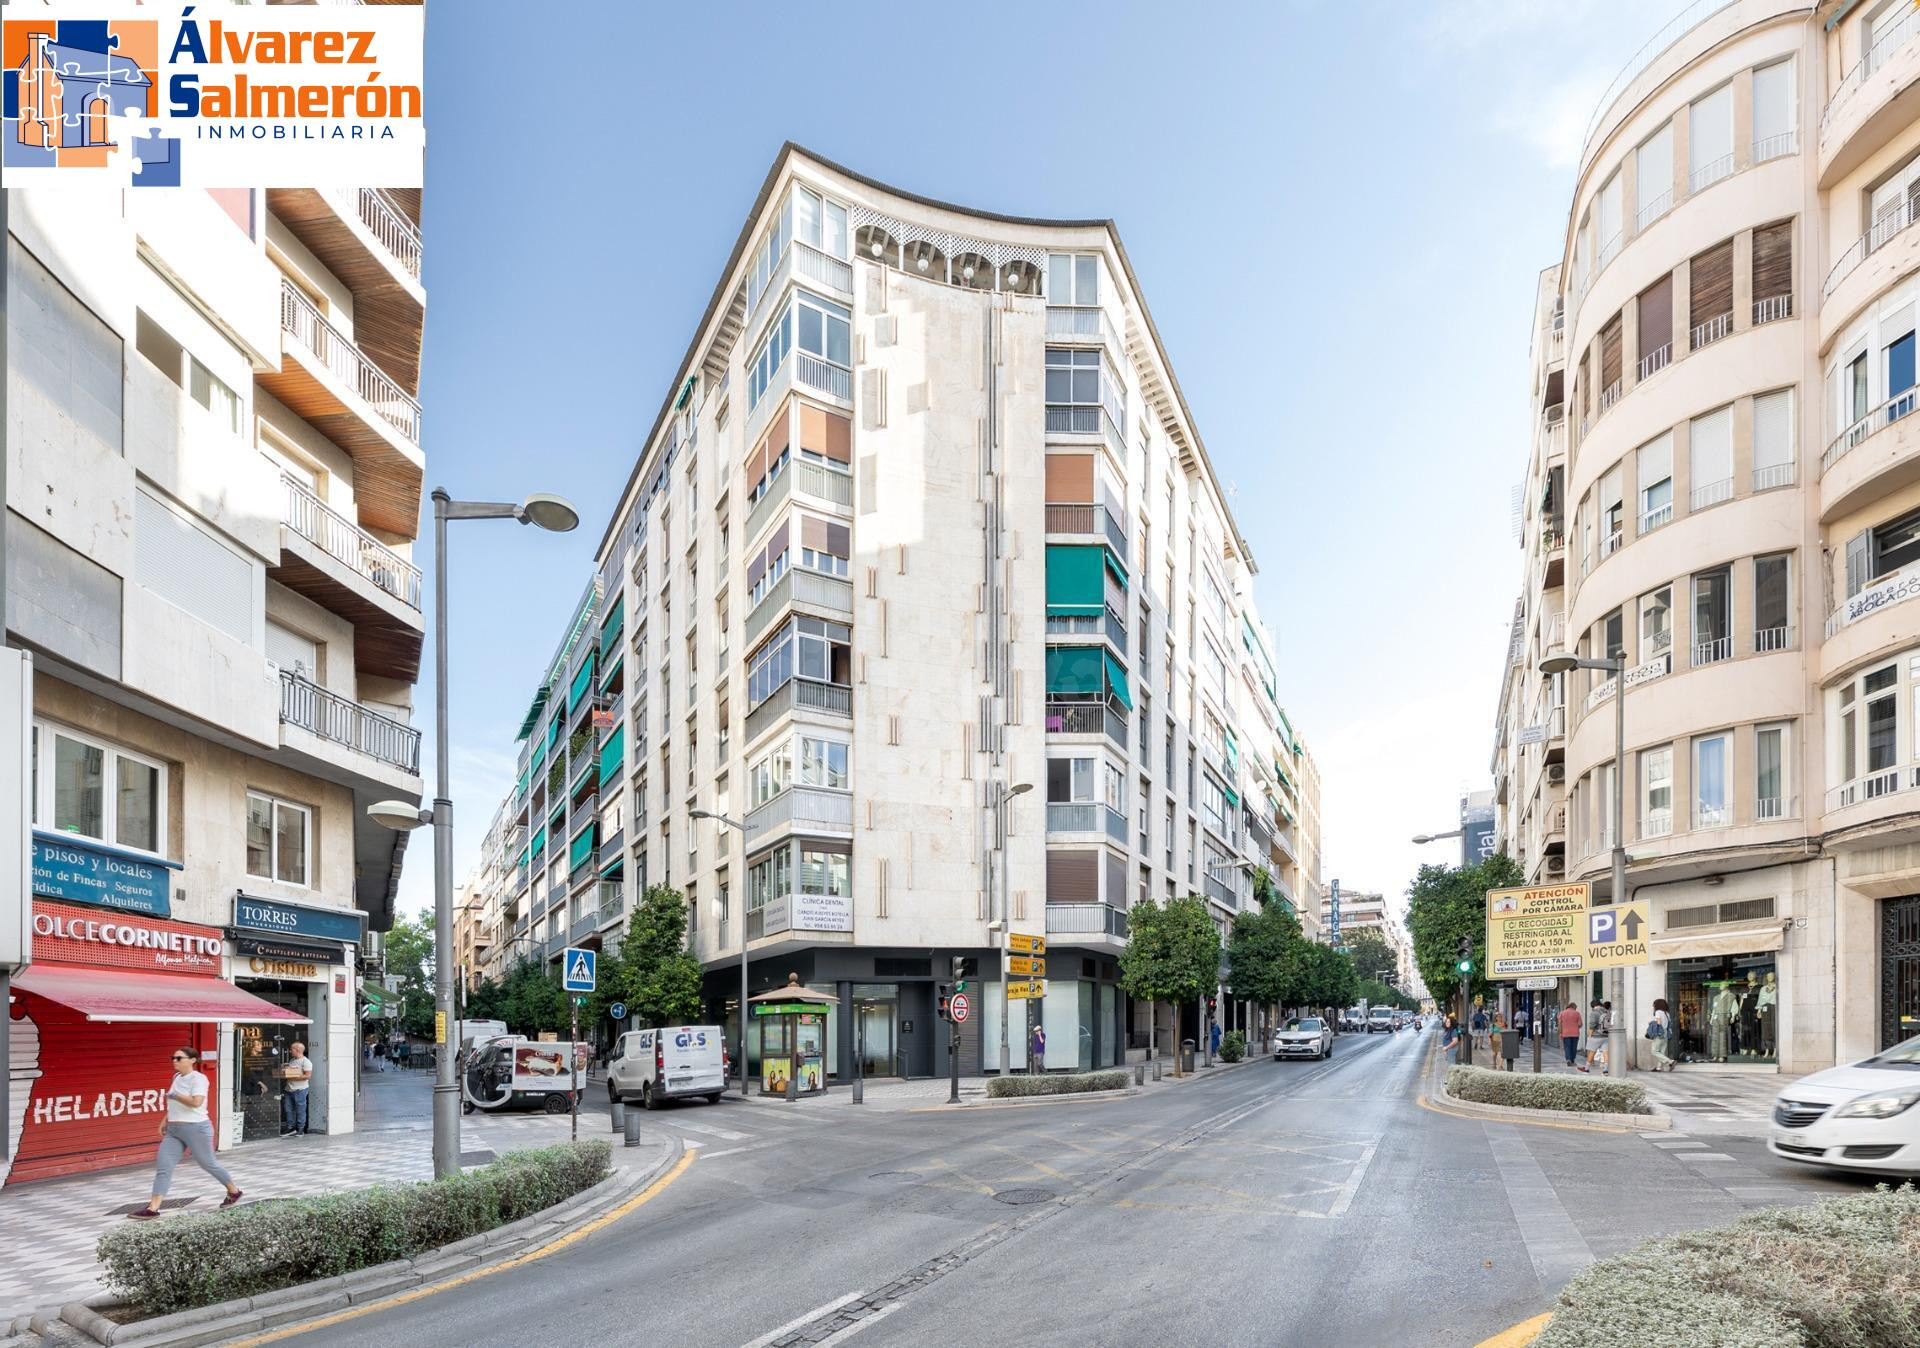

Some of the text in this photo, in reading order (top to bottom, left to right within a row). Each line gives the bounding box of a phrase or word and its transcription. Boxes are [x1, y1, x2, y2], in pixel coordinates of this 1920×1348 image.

[45, 848, 85, 866] pisos
[92, 859, 100, 871] y
[106, 858, 153, 879] locales
[57, 870, 69, 880] de
[73, 873, 106, 888] Fincas
[115, 882, 153, 896] Seguros
[101, 894, 153, 910] Alquileres
[1530, 898, 1574, 906] CONTROL
[242, 906, 297, 926] TORRES
[1519, 918, 1568, 928] RECOGIDAS
[1504, 930, 1559, 940] RESTRINGIDA
[1592, 914, 1613, 942] P
[1588, 943, 1647, 959] VICTORIA
[640, 1033, 653, 1049] GLS
[676, 1033, 706, 1047] GLS
[34, 1088, 165, 1124] HELADERI
